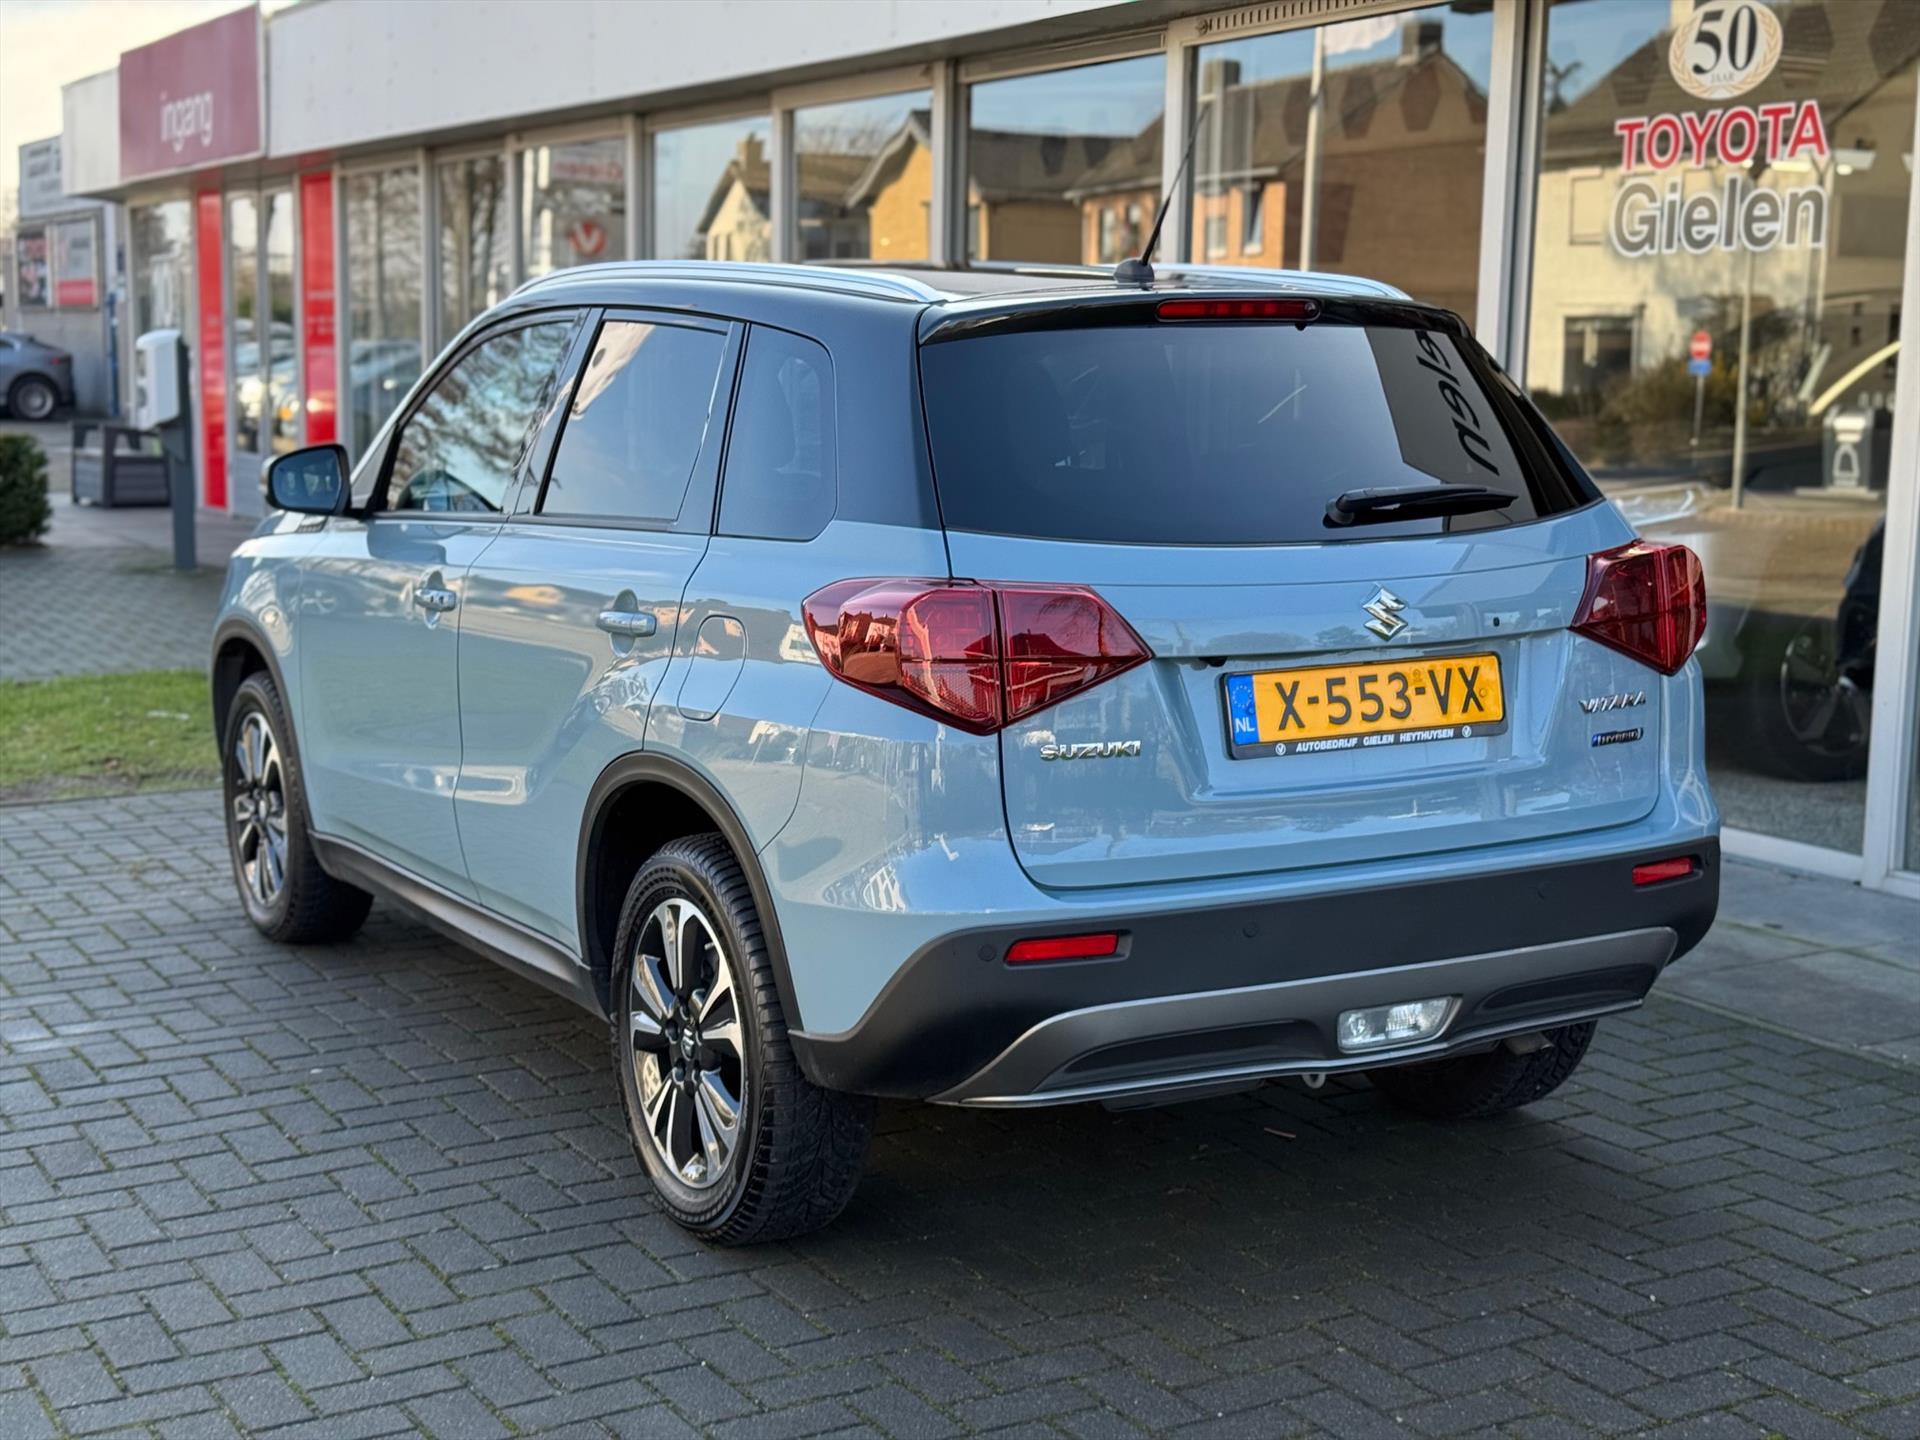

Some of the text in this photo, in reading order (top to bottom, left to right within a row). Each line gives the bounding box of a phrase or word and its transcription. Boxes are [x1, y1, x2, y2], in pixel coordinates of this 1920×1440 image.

[1692, 5, 1757, 75] 50
[160, 90, 214, 152] ingang
[1614, 100, 1829, 172] TOYOTA
[1611, 171, 1828, 257] Gielen
[1234, 716, 1256, 733] NL
[1273, 665, 1485, 731] X-553-VX
[1578, 690, 1647, 715] VITARA
[1039, 740, 1142, 761] SUZUKI
[1295, 736, 1358, 753] AUTOBEDRIJF
[1363, 733, 1395, 746] GIELEN
[1399, 728, 1455, 743] HEYTHUYSEN
